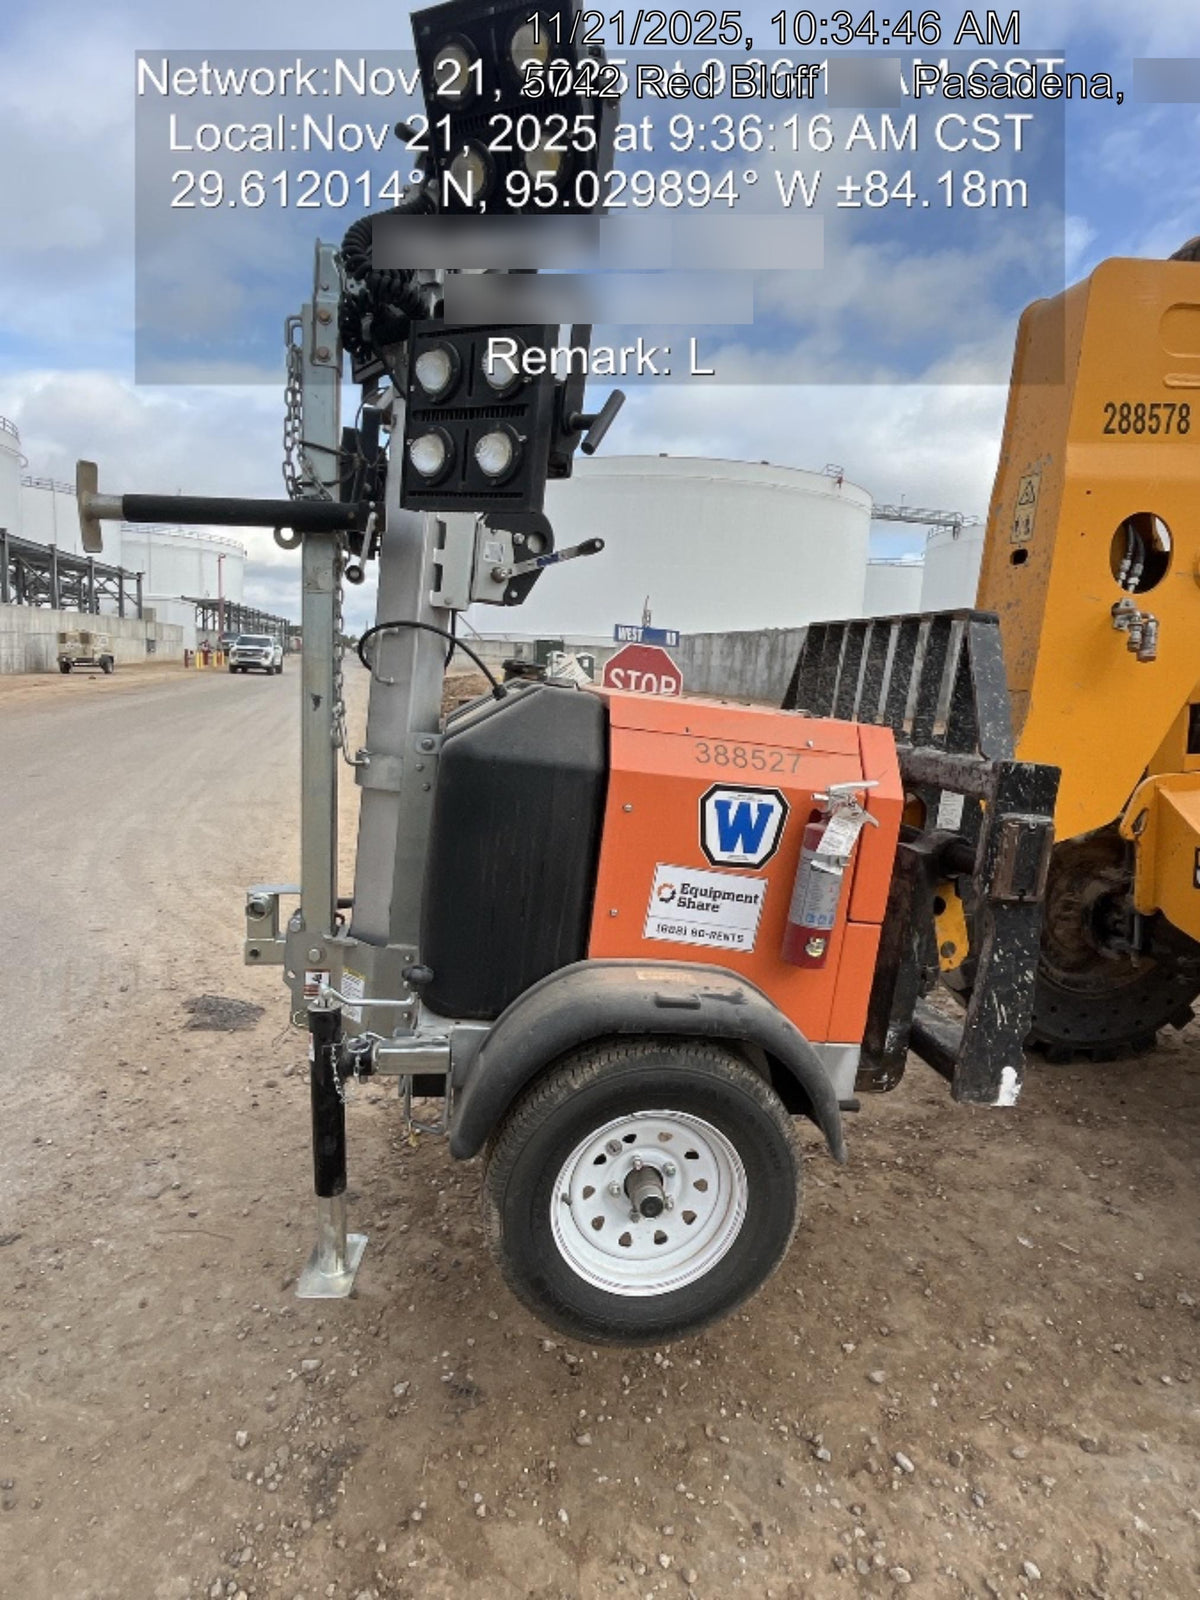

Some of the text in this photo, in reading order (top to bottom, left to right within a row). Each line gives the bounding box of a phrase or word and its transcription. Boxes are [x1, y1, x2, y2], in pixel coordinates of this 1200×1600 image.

[1104, 402, 1190, 435] 288578
[618, 626, 644, 642] WEST
[609, 667, 676, 693] STOP
[695, 742, 802, 774] 388527
[714, 799, 774, 854] W
[677, 896, 720, 912] Share
[680, 883, 760, 904] Equipment
